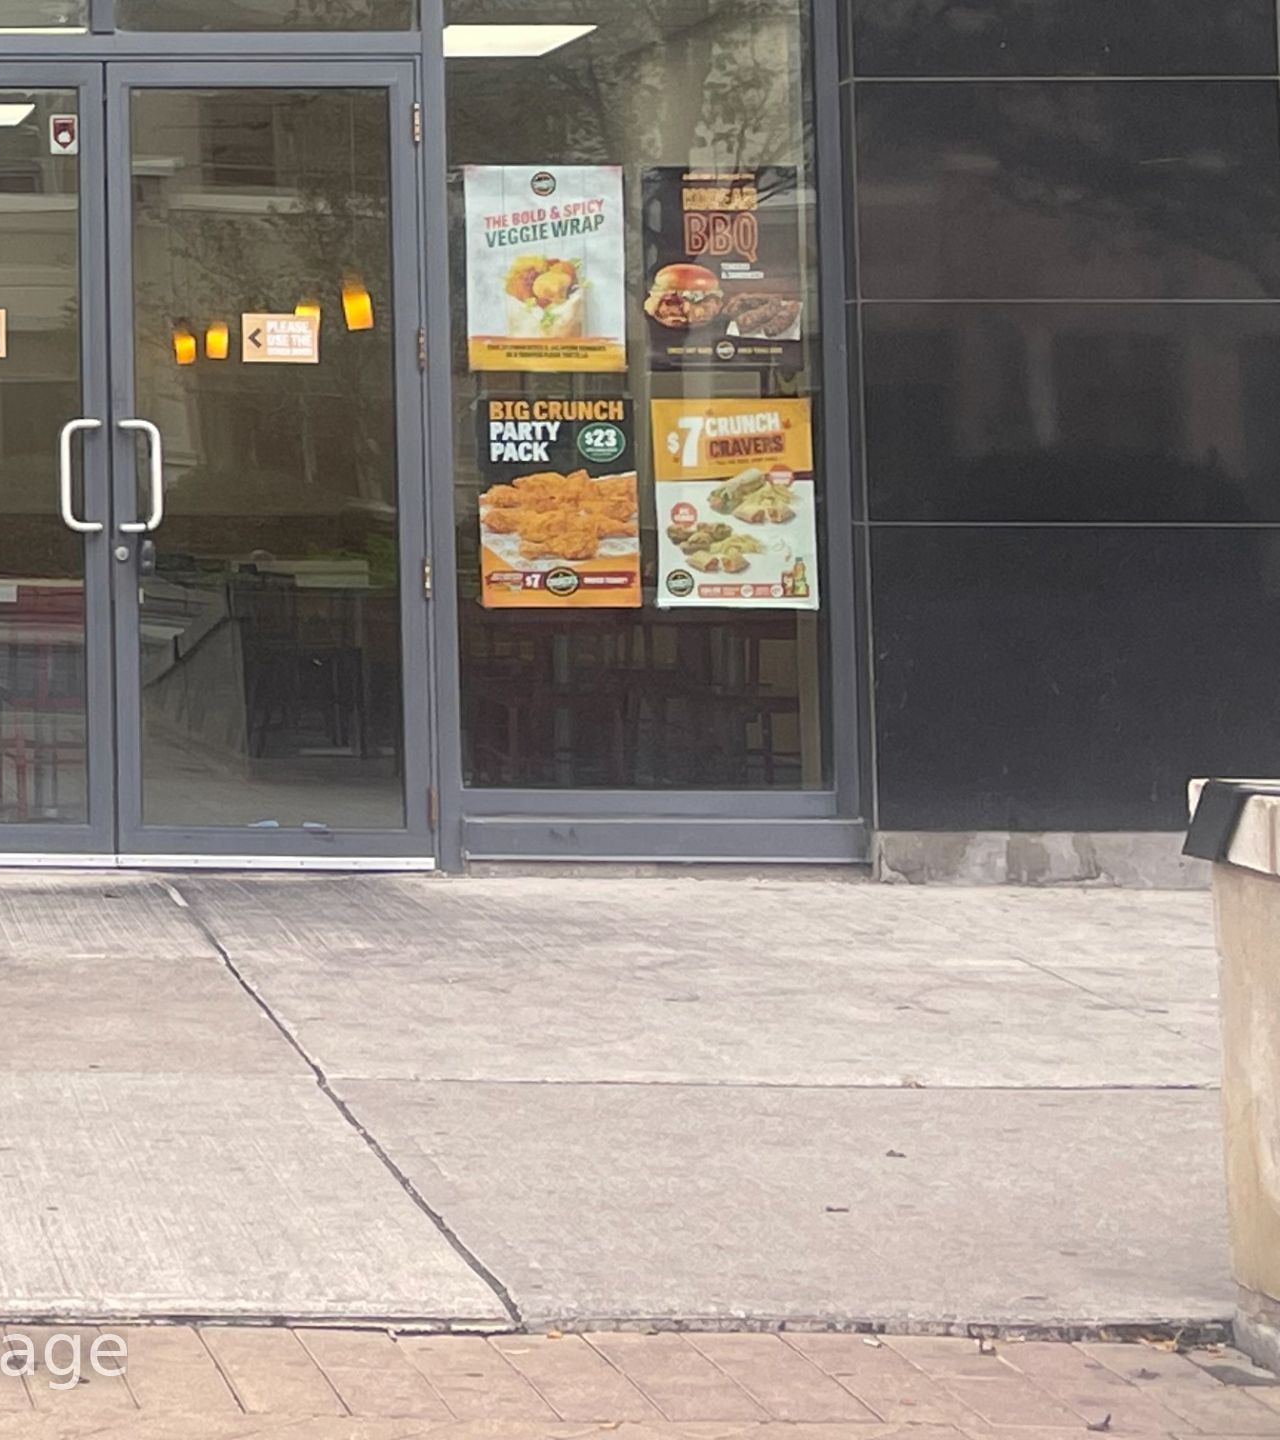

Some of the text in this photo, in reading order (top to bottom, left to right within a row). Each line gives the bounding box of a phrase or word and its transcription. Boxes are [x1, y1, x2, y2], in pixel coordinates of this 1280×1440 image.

[484, 198, 605, 230] THE BOLD & SPICY
[485, 213, 605, 248] VEGGIE WRAP
[683, 211, 759, 263] BBQ
[489, 400, 625, 421] BIG CRUNCH
[489, 421, 561, 442] PARTY
[705, 411, 781, 437] CRUNCH
[584, 428, 618, 448] $23
[667, 415, 705, 468] $7
[709, 435, 784, 458] CRAVERS
[489, 441, 551, 462] PACK
